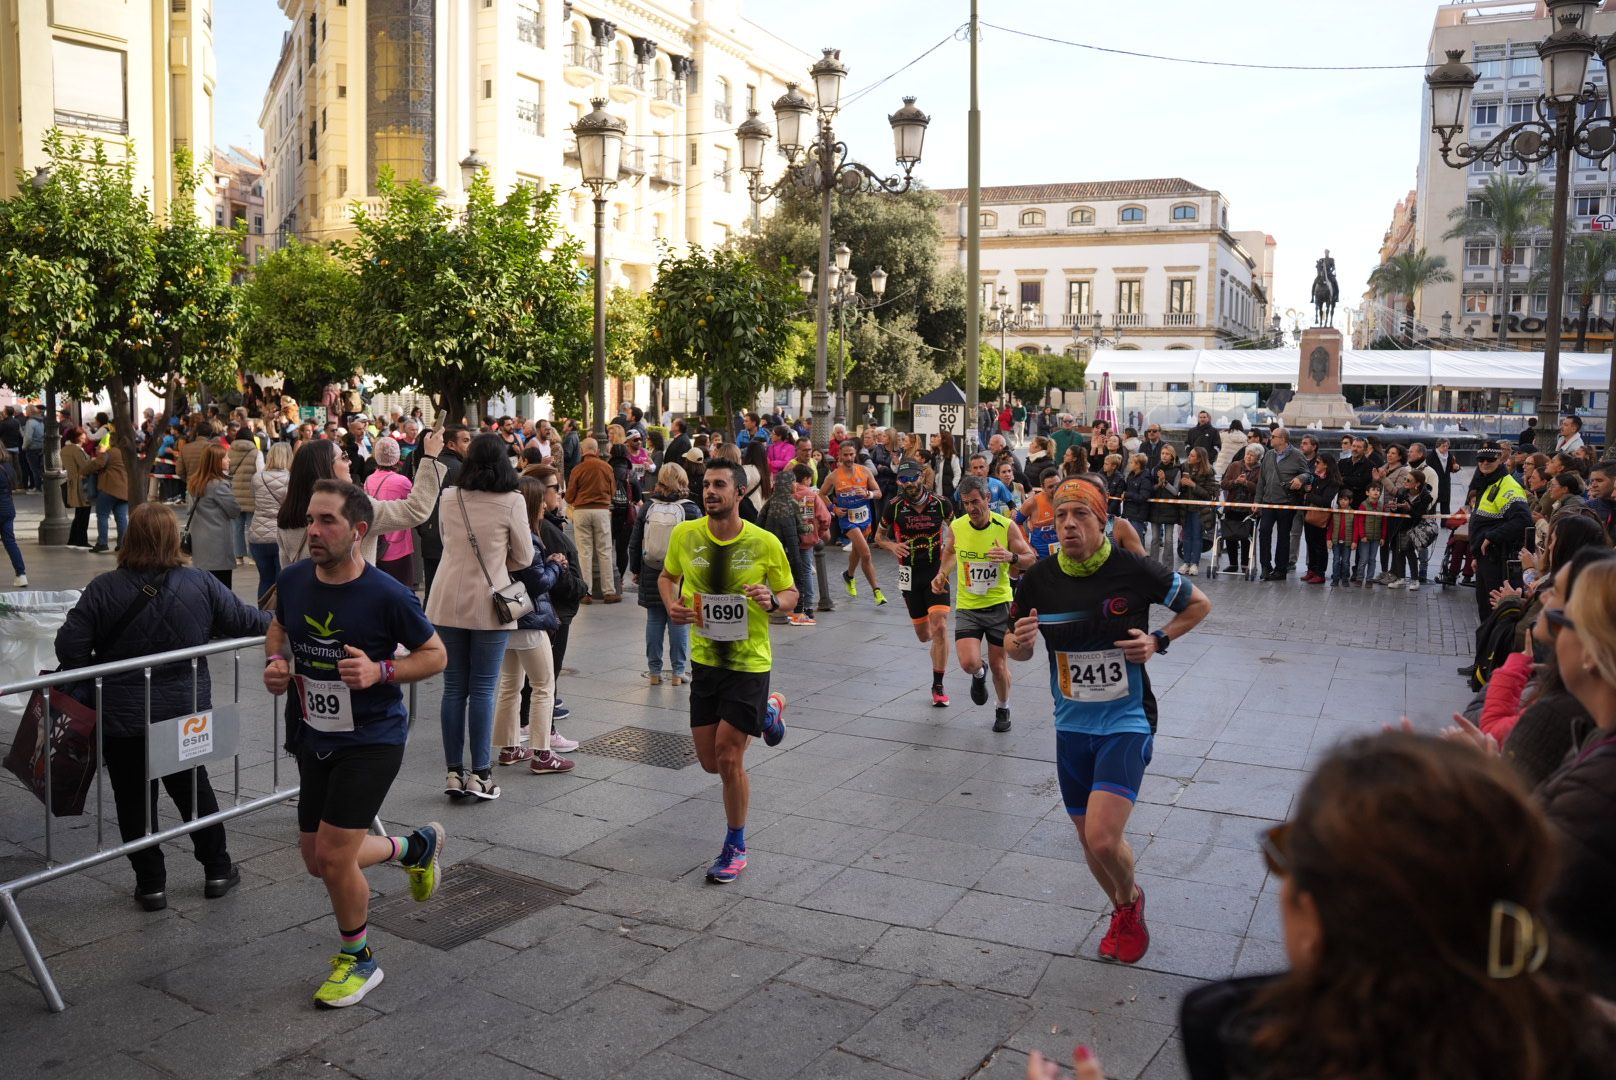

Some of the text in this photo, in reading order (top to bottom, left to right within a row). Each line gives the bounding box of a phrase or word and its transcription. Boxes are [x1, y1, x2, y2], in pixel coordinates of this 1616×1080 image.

[939, 404, 959, 413] GRI
[939, 414, 956, 424] GO
[970, 568, 997, 580] 1704
[703, 604, 744, 620] 1690
[294, 643, 352, 658] Extremadu
[1070, 662, 1122, 683] 2413
[307, 691, 340, 715] 389
[183, 733, 209, 747] esm
[551, 760, 561, 768] N
